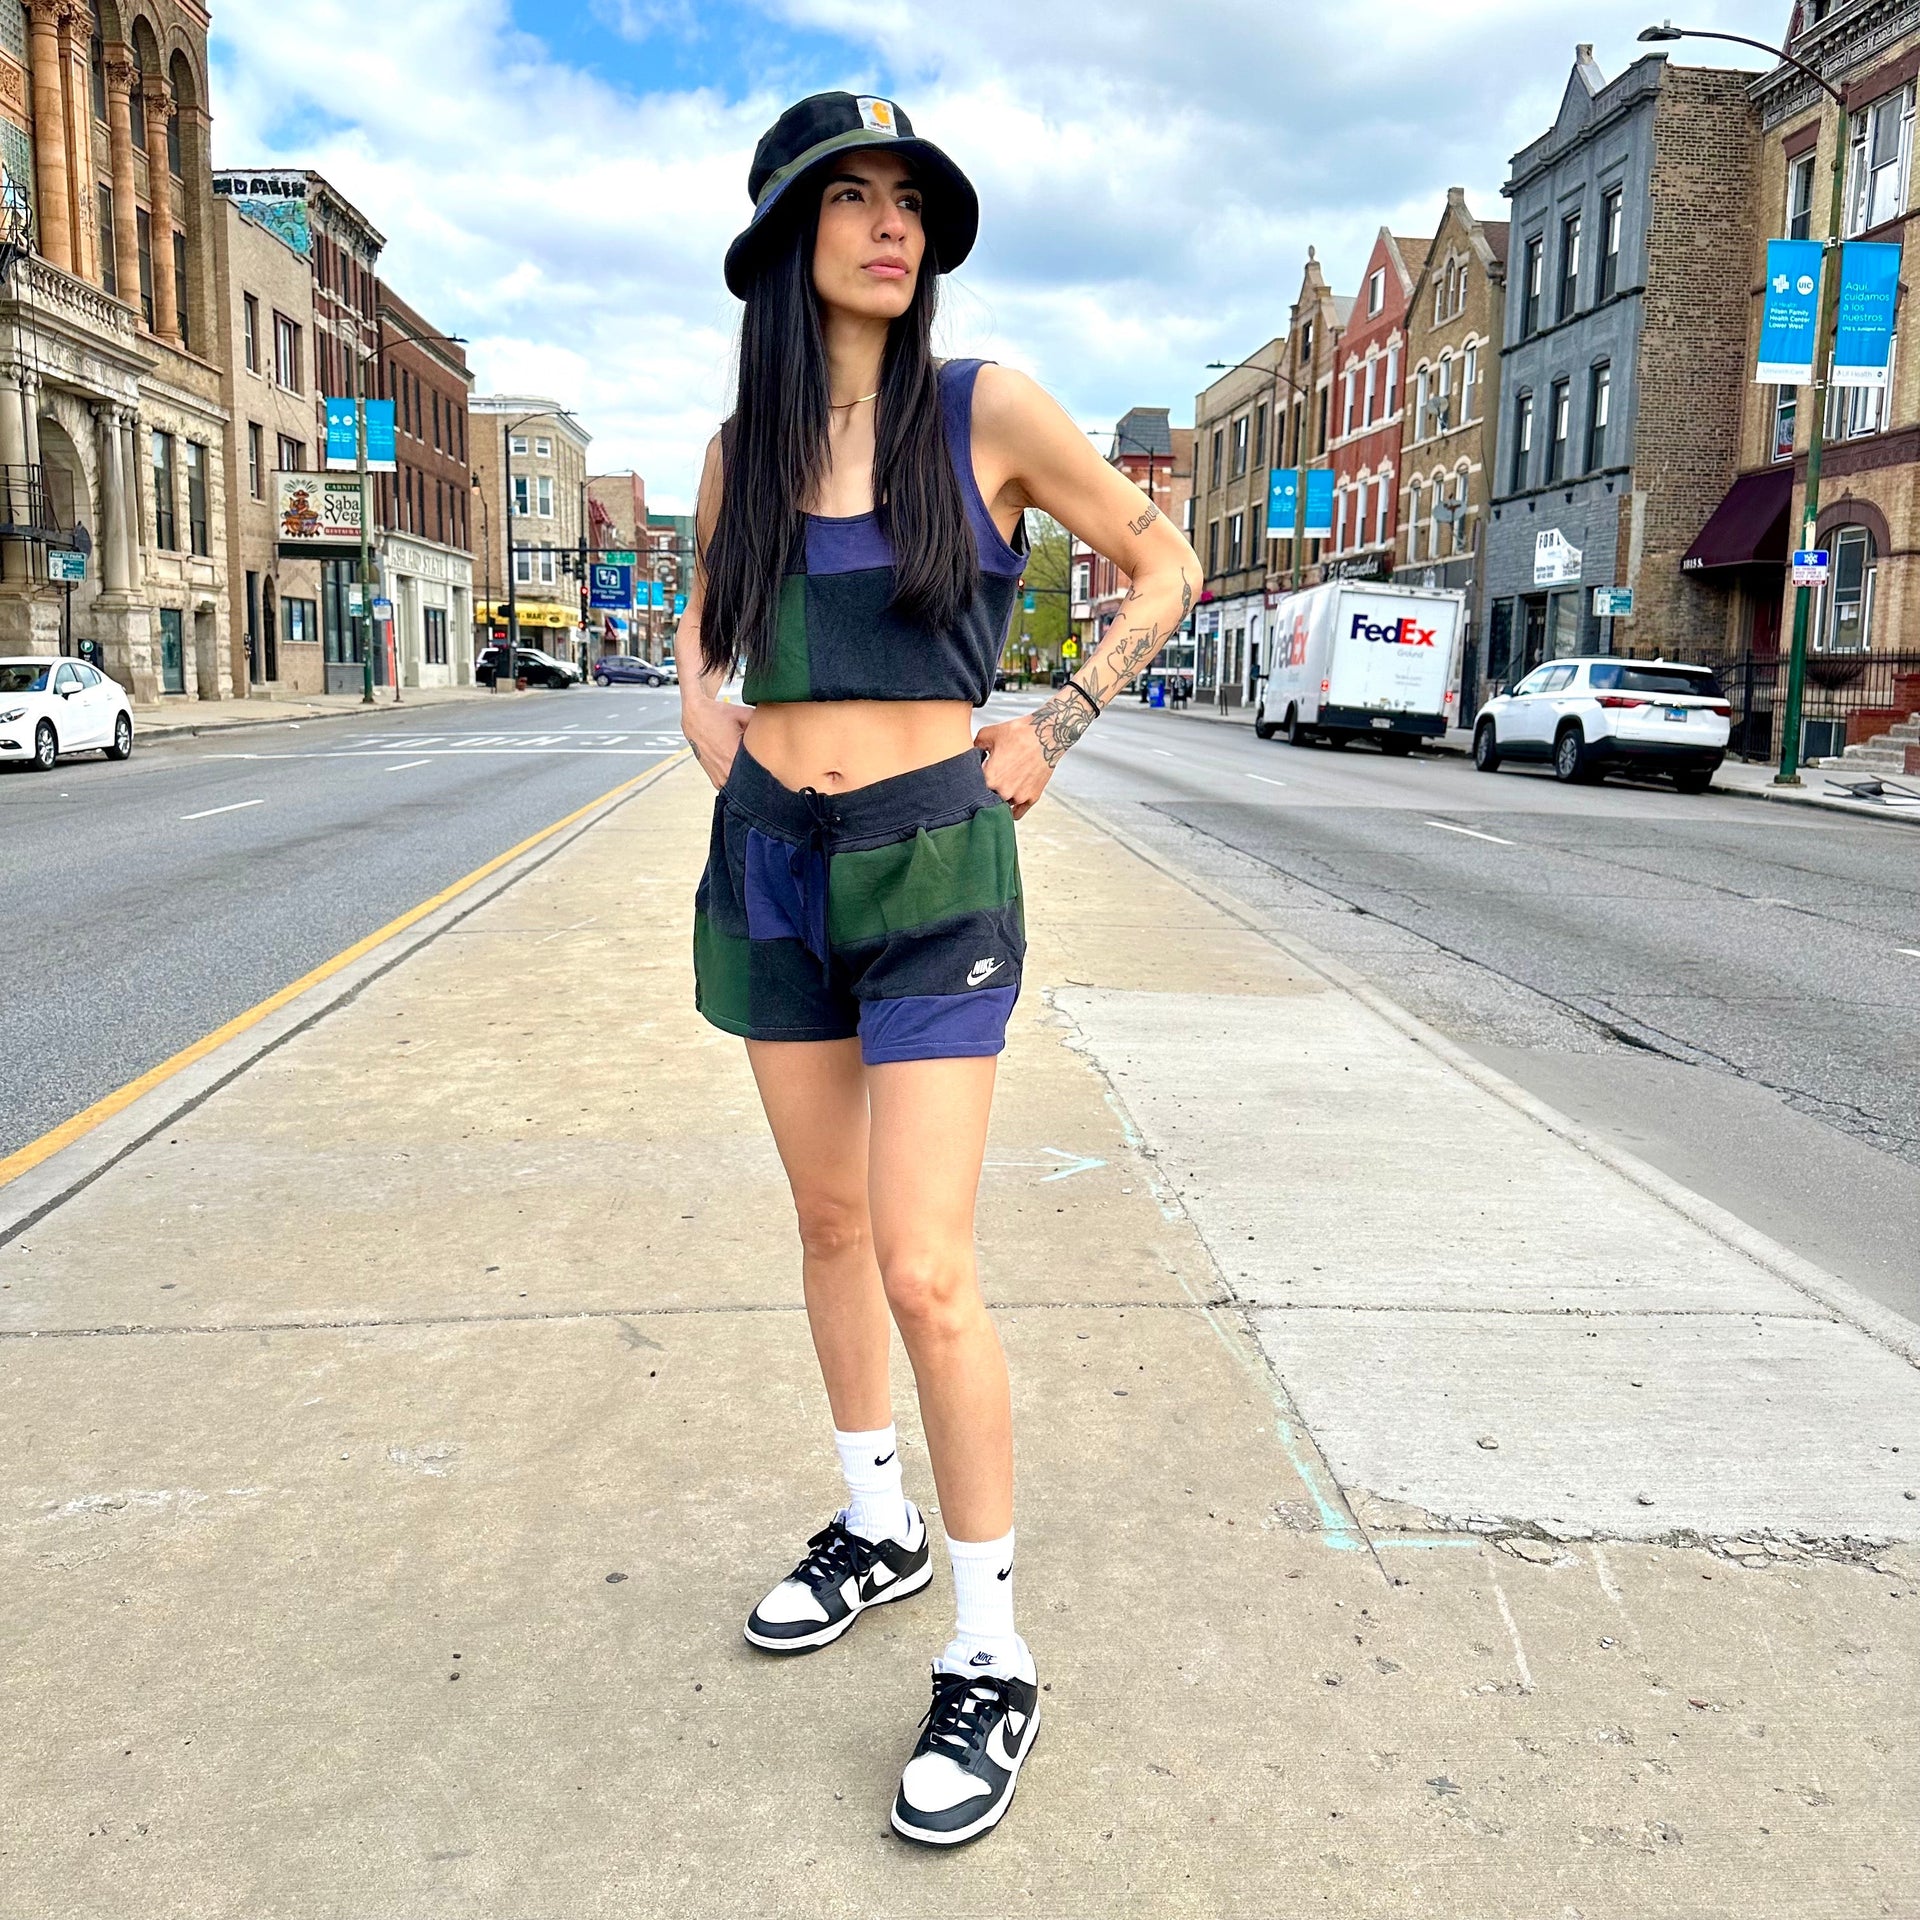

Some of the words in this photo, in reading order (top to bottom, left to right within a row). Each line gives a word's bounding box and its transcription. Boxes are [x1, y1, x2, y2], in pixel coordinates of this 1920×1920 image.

[1798, 281, 1811, 289] UIC
[1844, 292, 1890, 302] cuidamos
[1770, 307, 1788, 315] Pilsen
[1788, 308, 1809, 317] Family
[1843, 303, 1849, 311] a
[1851, 303, 1865, 312] los
[1769, 314, 1789, 322] Health
[1789, 315, 1811, 323] Center
[1842, 313, 1883, 322] nuestros
[1768, 321, 1787, 329] Lower
[1788, 322, 1804, 330] West
[324, 493, 360, 511] Saba
[1538, 533, 1554, 549] FOR
[1350, 613, 1437, 647] FedEx
[1273, 614, 1309, 669] FedEx
[972, 956, 996, 976] NIKE
[975, 1651, 997, 1662] NIKE
